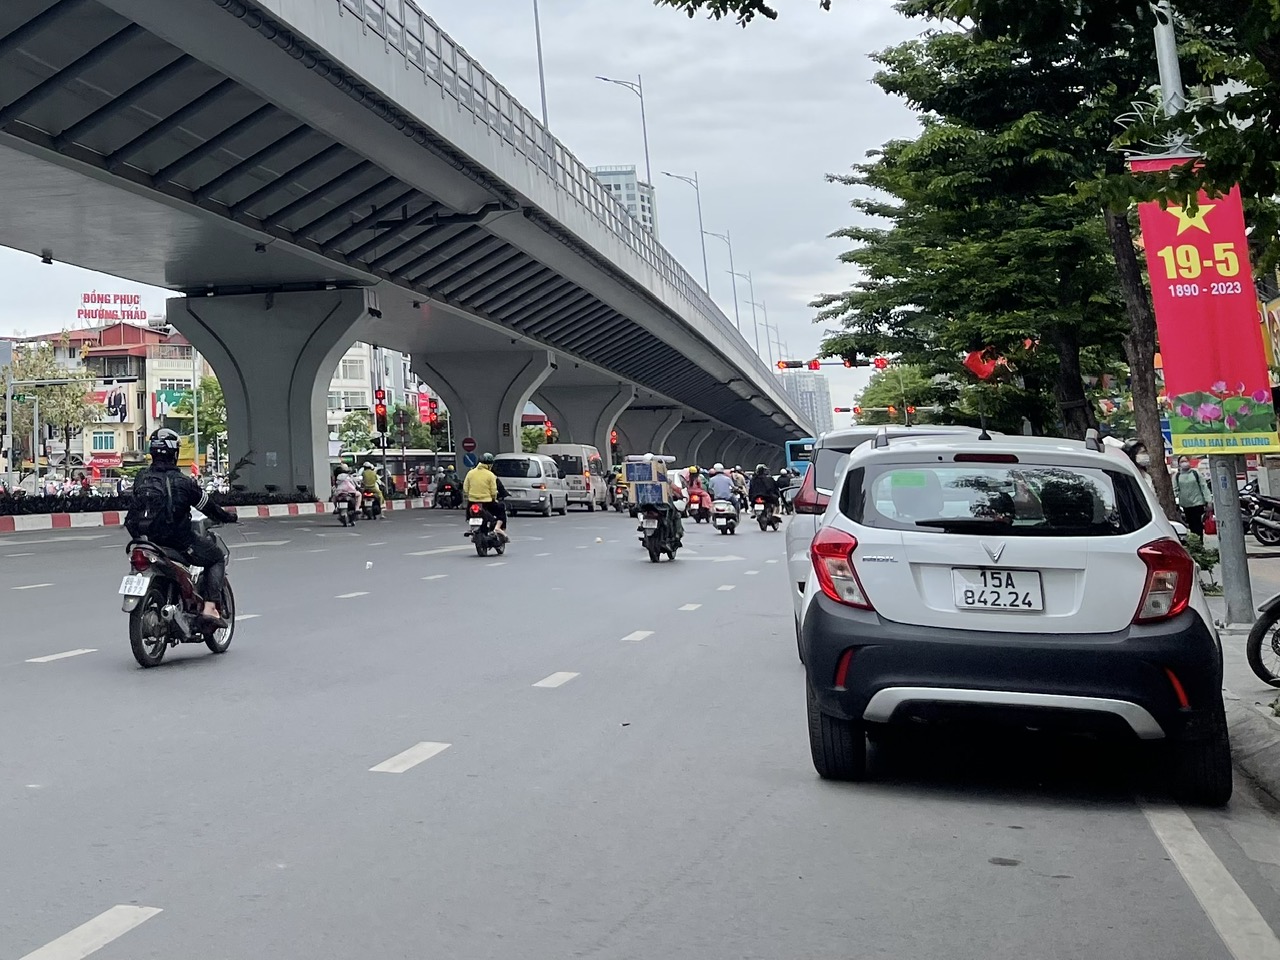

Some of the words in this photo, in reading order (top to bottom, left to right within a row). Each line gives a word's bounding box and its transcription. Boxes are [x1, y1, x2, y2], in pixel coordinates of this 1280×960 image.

[1157, 242, 1240, 280] 19-5
[1168, 283, 1199, 297] 1890
[1210, 281, 1242, 295] 2023
[113, 293, 140, 307] PHỤC
[121, 306, 147, 320] THẢO
[1208, 438, 1223, 447] HAI
[1225, 436, 1238, 447] BÀ
[980, 570, 1016, 589] 15A
[964, 589, 1033, 608] 842.24
